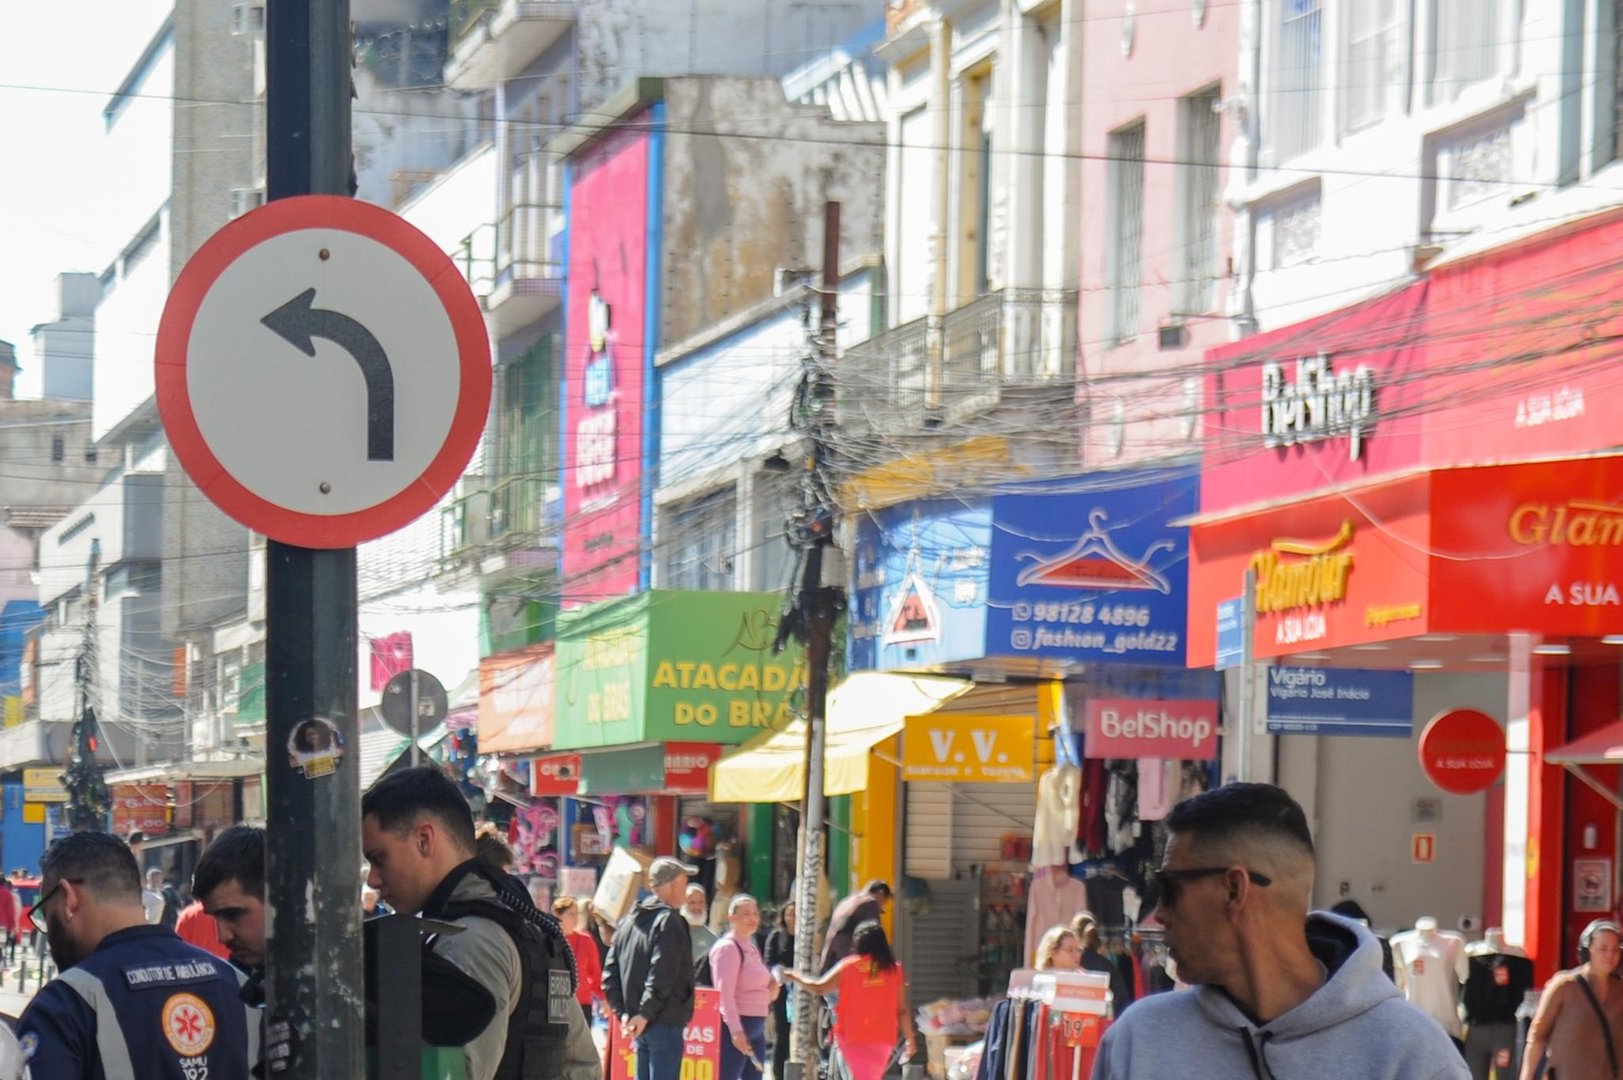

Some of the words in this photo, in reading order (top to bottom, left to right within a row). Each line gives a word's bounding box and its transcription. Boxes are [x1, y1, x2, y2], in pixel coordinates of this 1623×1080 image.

[1543, 582, 1564, 605] A
[1569, 581, 1621, 606] SUA
[1033, 601, 1095, 624] 98128
[1097, 604, 1150, 627] 4896
[1271, 668, 1326, 689] Vigário
[674, 702, 718, 726] DO
[1100, 708, 1211, 748] BelShop
[179, 1056, 208, 1069] SAMU
[686, 1045, 704, 1056] DE
